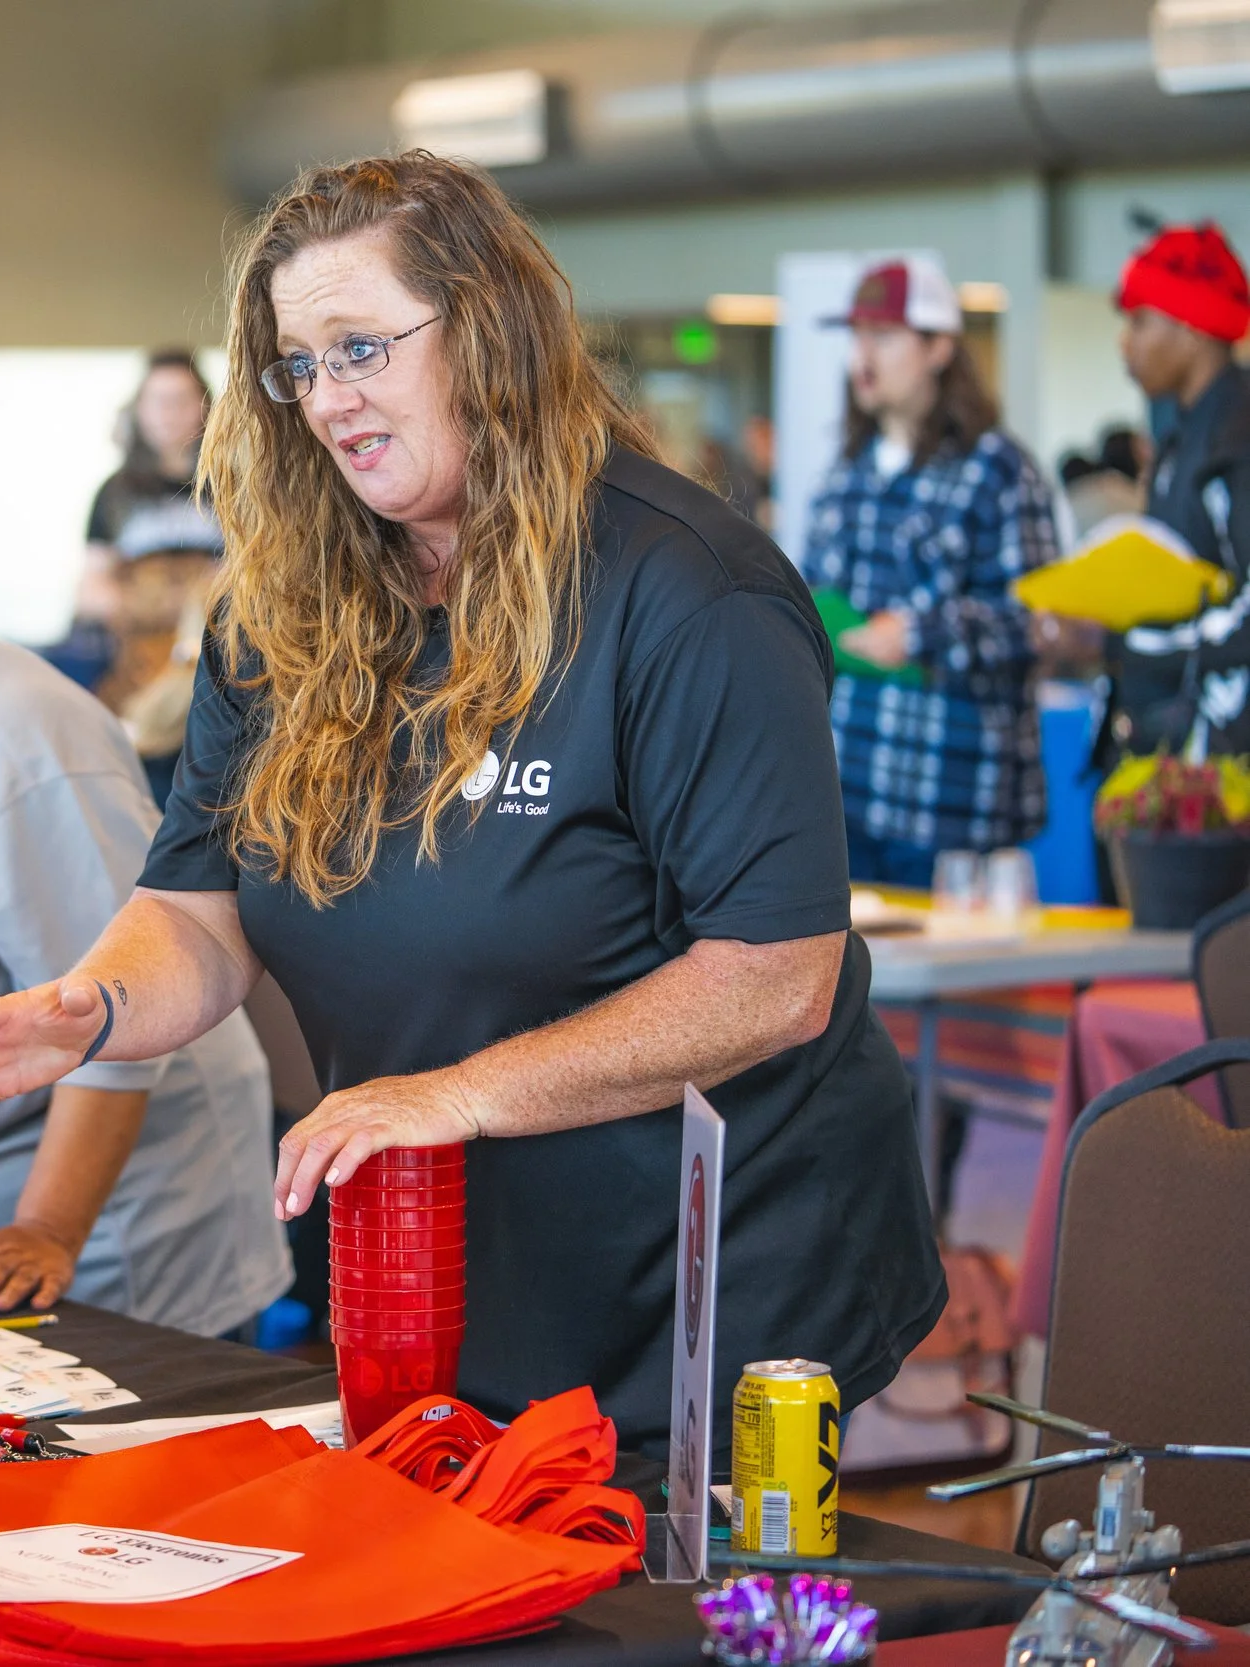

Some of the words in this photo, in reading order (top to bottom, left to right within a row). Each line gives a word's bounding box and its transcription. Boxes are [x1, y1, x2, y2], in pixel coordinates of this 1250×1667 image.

[502, 759, 552, 797] LG
[496, 801, 522, 814] Life's
[525, 802, 550, 816] Good
[390, 1364, 435, 1392] LG
[747, 1413, 761, 1424] 170
[78, 1531, 119, 1541] LG
[116, 1537, 229, 1564] Electronics
[110, 1552, 152, 1565] LG
